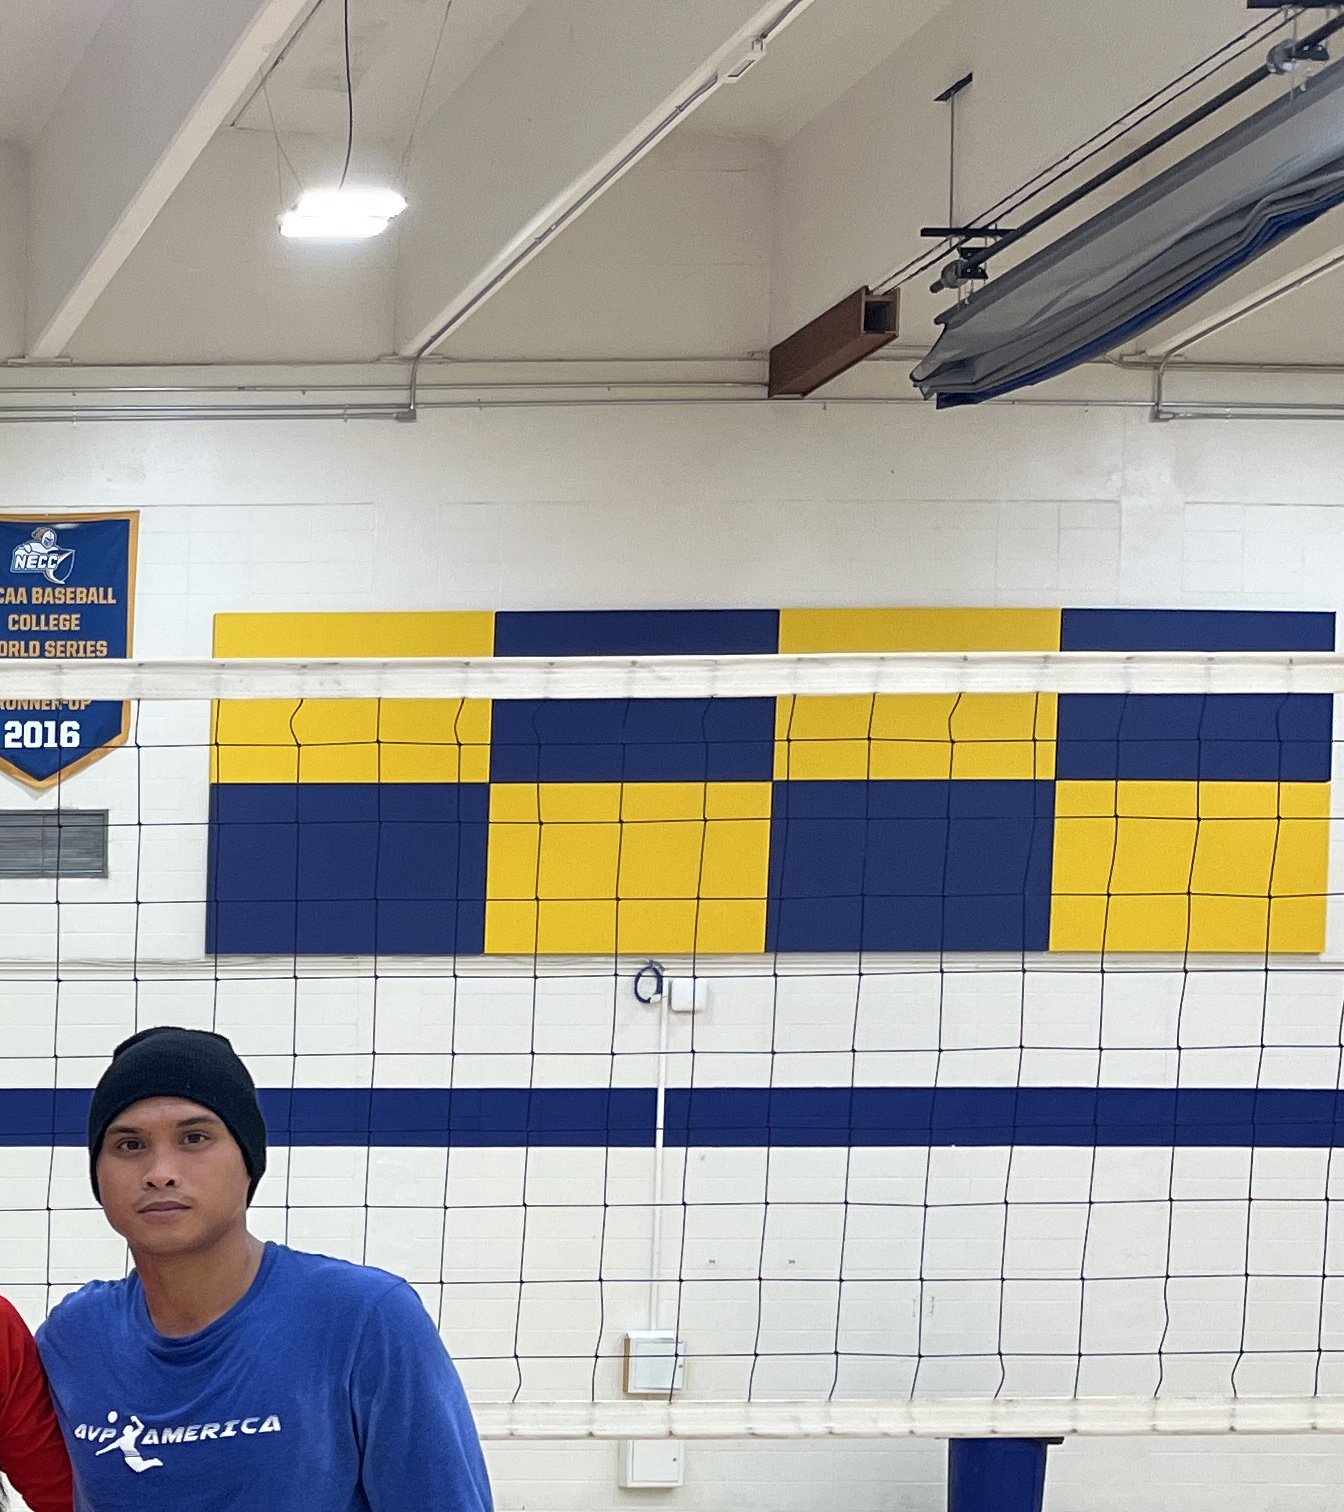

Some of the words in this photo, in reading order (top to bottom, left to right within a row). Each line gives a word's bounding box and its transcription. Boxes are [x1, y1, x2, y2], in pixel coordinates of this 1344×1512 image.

[14, 555, 59, 569] NECC
[31, 587, 117, 604] BASEBALL
[8, 613, 81, 631] COLLEGE
[44, 640, 108, 658] SERIES
[4, 720, 81, 749] 2016
[74, 1423, 117, 1443] AVP
[140, 1414, 282, 1446] AMERICA
